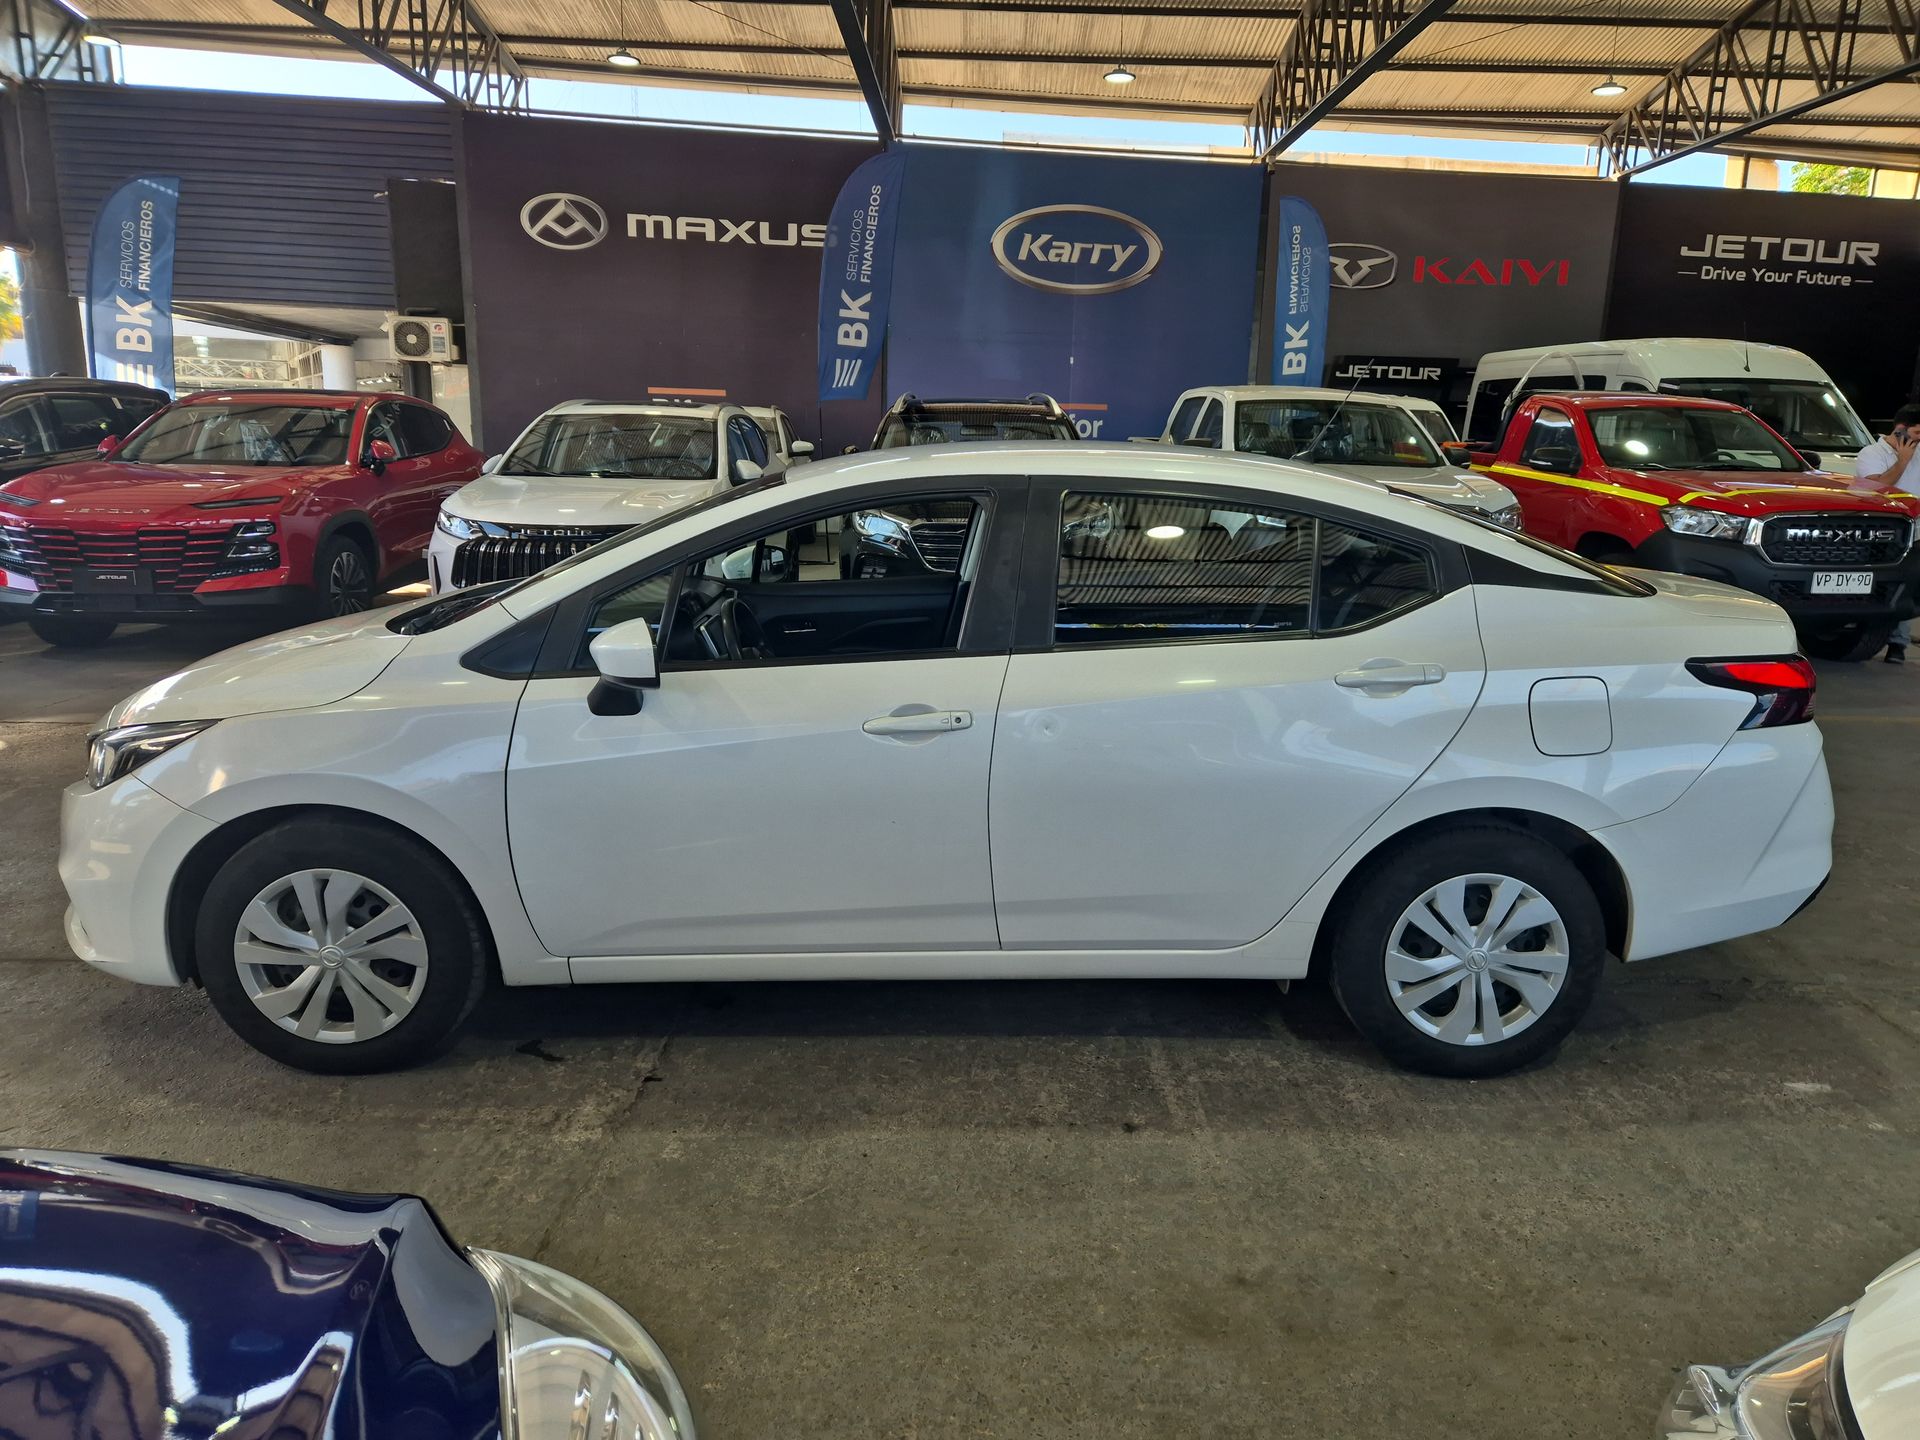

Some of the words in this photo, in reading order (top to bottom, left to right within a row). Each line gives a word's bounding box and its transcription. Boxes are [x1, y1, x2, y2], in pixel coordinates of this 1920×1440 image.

[119, 220, 136, 289] SERVICIOS
[138, 200, 154, 292] FINANCIEROS
[627, 213, 830, 248] MAXUS
[846, 208, 864, 281] SERVICIOS
[860, 184, 882, 283] FINANCIEROS
[1016, 232, 1138, 272] Karry
[1680, 233, 1880, 267] JETOUR
[1700, 266, 1746, 282] Drive
[1752, 268, 1793, 284] Your
[1796, 270, 1852, 286] Future
[116, 295, 153, 353] BK
[837, 288, 872, 348] BK
[1336, 363, 1442, 382] JETOUR
[1786, 528, 1896, 542] MAXUS
